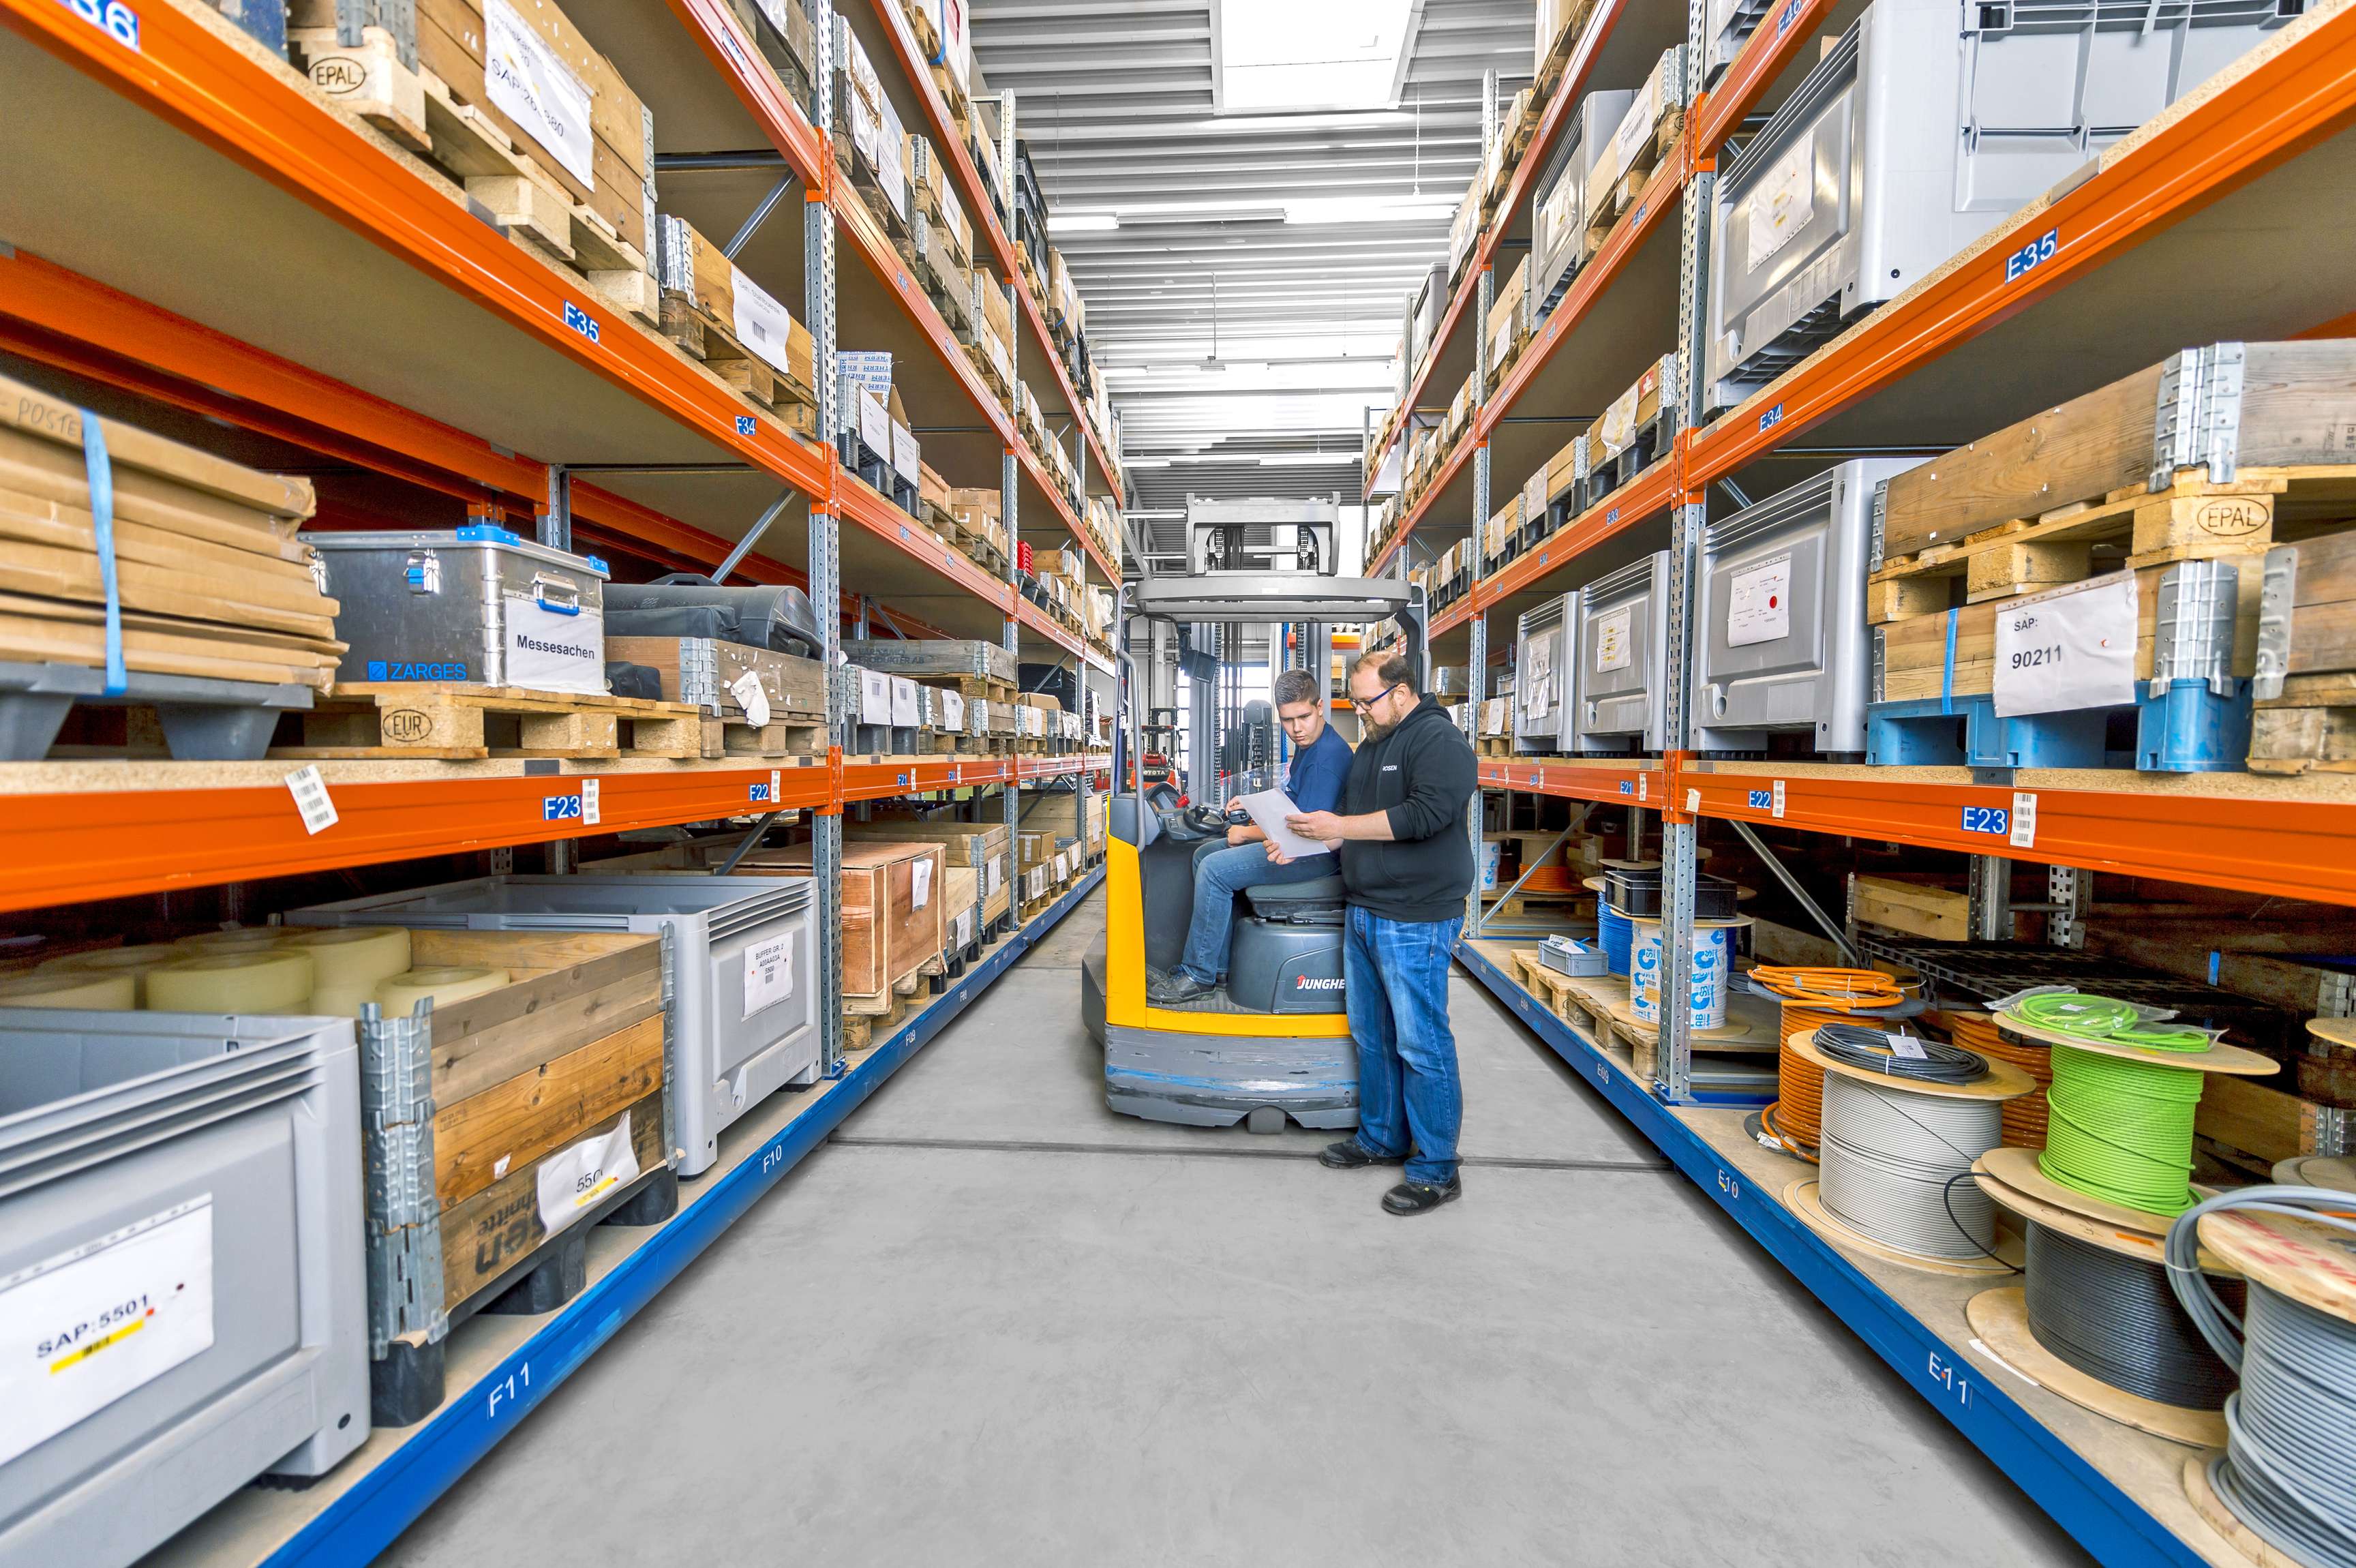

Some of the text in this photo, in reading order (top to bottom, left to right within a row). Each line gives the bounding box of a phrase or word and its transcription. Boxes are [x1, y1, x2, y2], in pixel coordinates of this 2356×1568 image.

[1778, 0, 1802, 40] E46
[316, 65, 357, 87] EPAL
[2006, 230, 2057, 284] E35
[564, 301, 599, 343] F35
[736, 416, 755, 435] F34
[1760, 404, 1783, 433] E34
[1607, 508, 1618, 525] E33
[2208, 507, 2258, 527] EPAL
[2014, 617, 2038, 633] SAP:
[517, 634, 595, 660] Messesachen
[2012, 644, 2062, 670] 90211
[391, 663, 468, 681] ZARGES
[393, 716, 422, 738] EUR
[898, 774, 907, 785] F21
[1620, 781, 1633, 795] E21
[750, 784, 769, 802] F22
[1749, 791, 1771, 809] E22
[545, 795, 580, 821] F23
[1963, 806, 2006, 834] E23
[906, 1029, 916, 1046] F09
[1597, 1063, 1609, 1084] E09
[764, 1145, 782, 1173] F10
[1719, 1169, 1738, 1199] E10
[36, 1291, 150, 1360] SAP:5501
[489, 1361, 530, 1418] F11
[1929, 1351, 1966, 1404] E11
